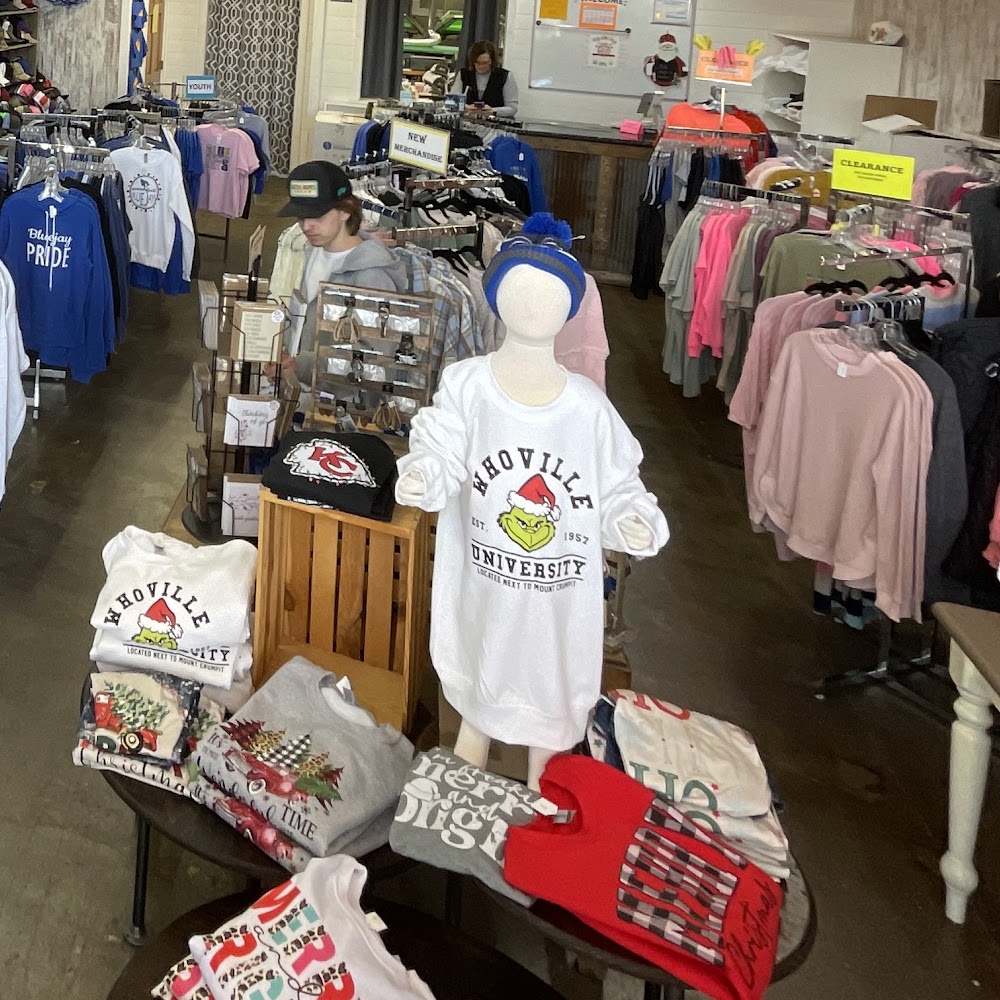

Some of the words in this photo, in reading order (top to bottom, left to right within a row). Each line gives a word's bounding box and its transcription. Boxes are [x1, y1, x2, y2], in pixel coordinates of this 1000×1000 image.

[188, 83, 212, 91] YOUTH
[407, 131, 429, 145] NEW
[393, 142, 444, 164] MERCHANDISE
[840, 159, 904, 175] CLEARANCE
[27, 227, 72, 247] Bluejay
[26, 242, 72, 269] PRIDE
[472, 446, 594, 509] WHOVILLE
[471, 516, 489, 532] EST.
[564, 532, 589, 545] 1957
[471, 543, 586, 579] UNIVERSITY
[477, 567, 501, 583] LOCATED
[502, 579, 521, 590] NEXT
[523, 582, 533, 590] TO
[534, 582, 556, 593] MOUNT
[104, 581, 211, 627] WHOVILLE
[127, 647, 152, 658] LOCATED
[153, 652, 168, 661] NEXT
[178, 657, 198, 667] MOUNT
[281, 803, 318, 841] TIME
